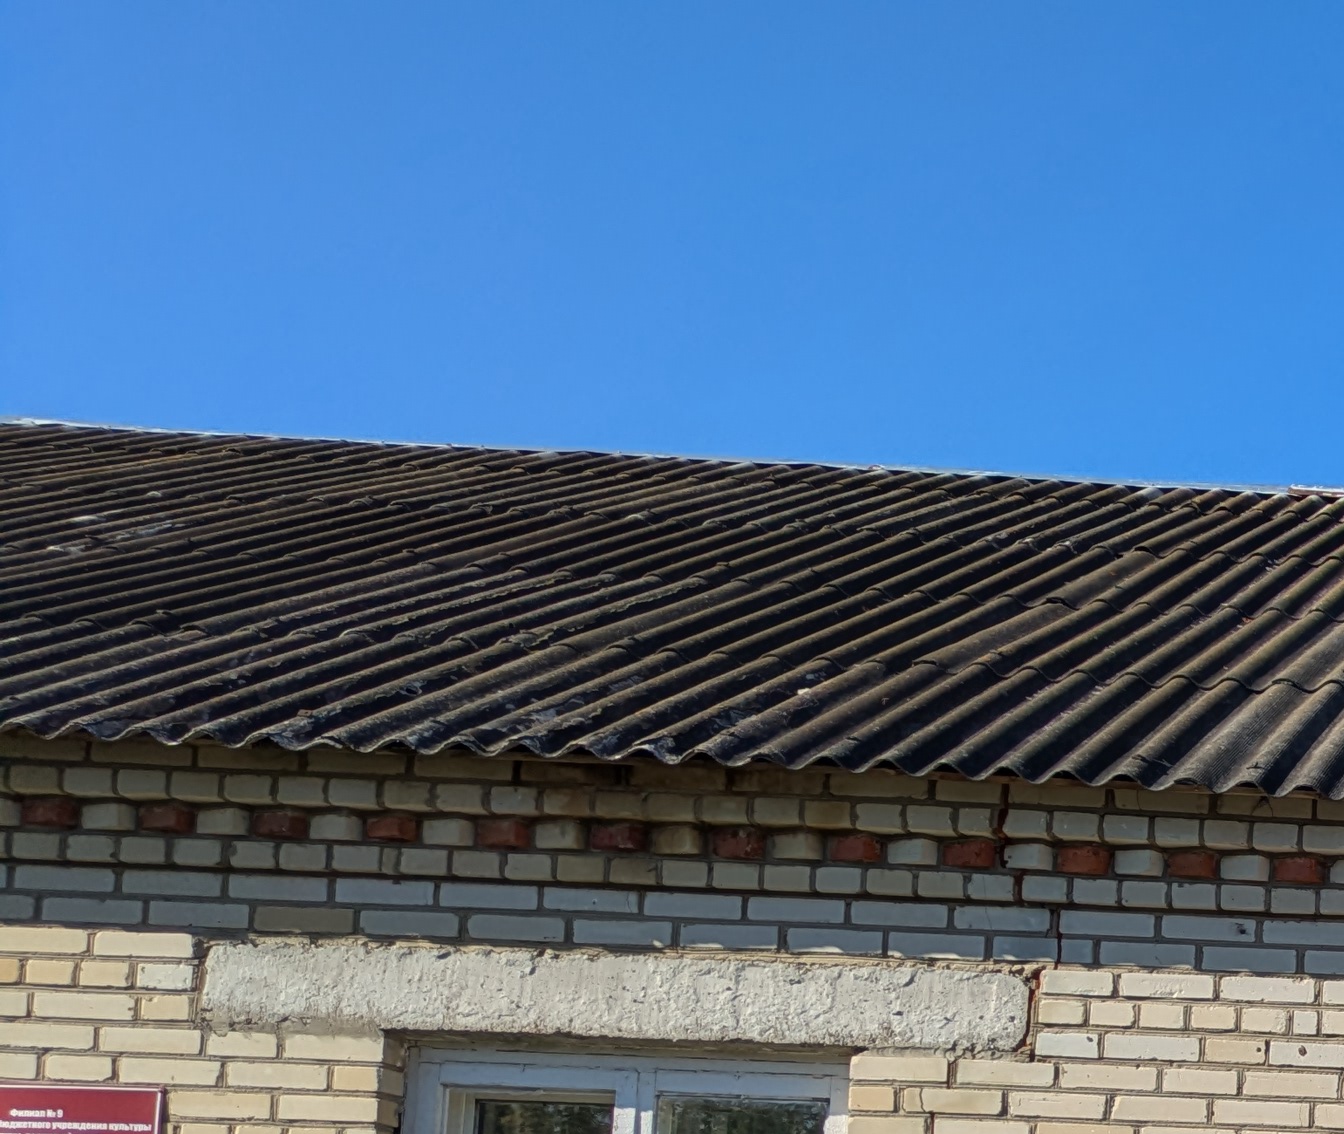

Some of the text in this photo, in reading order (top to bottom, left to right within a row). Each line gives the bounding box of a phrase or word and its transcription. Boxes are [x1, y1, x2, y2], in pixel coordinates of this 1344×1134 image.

[10, 1109, 46, 1117] Филиал
[57, 1109, 63, 1118] 9
[109, 1123, 152, 1131] культуры
